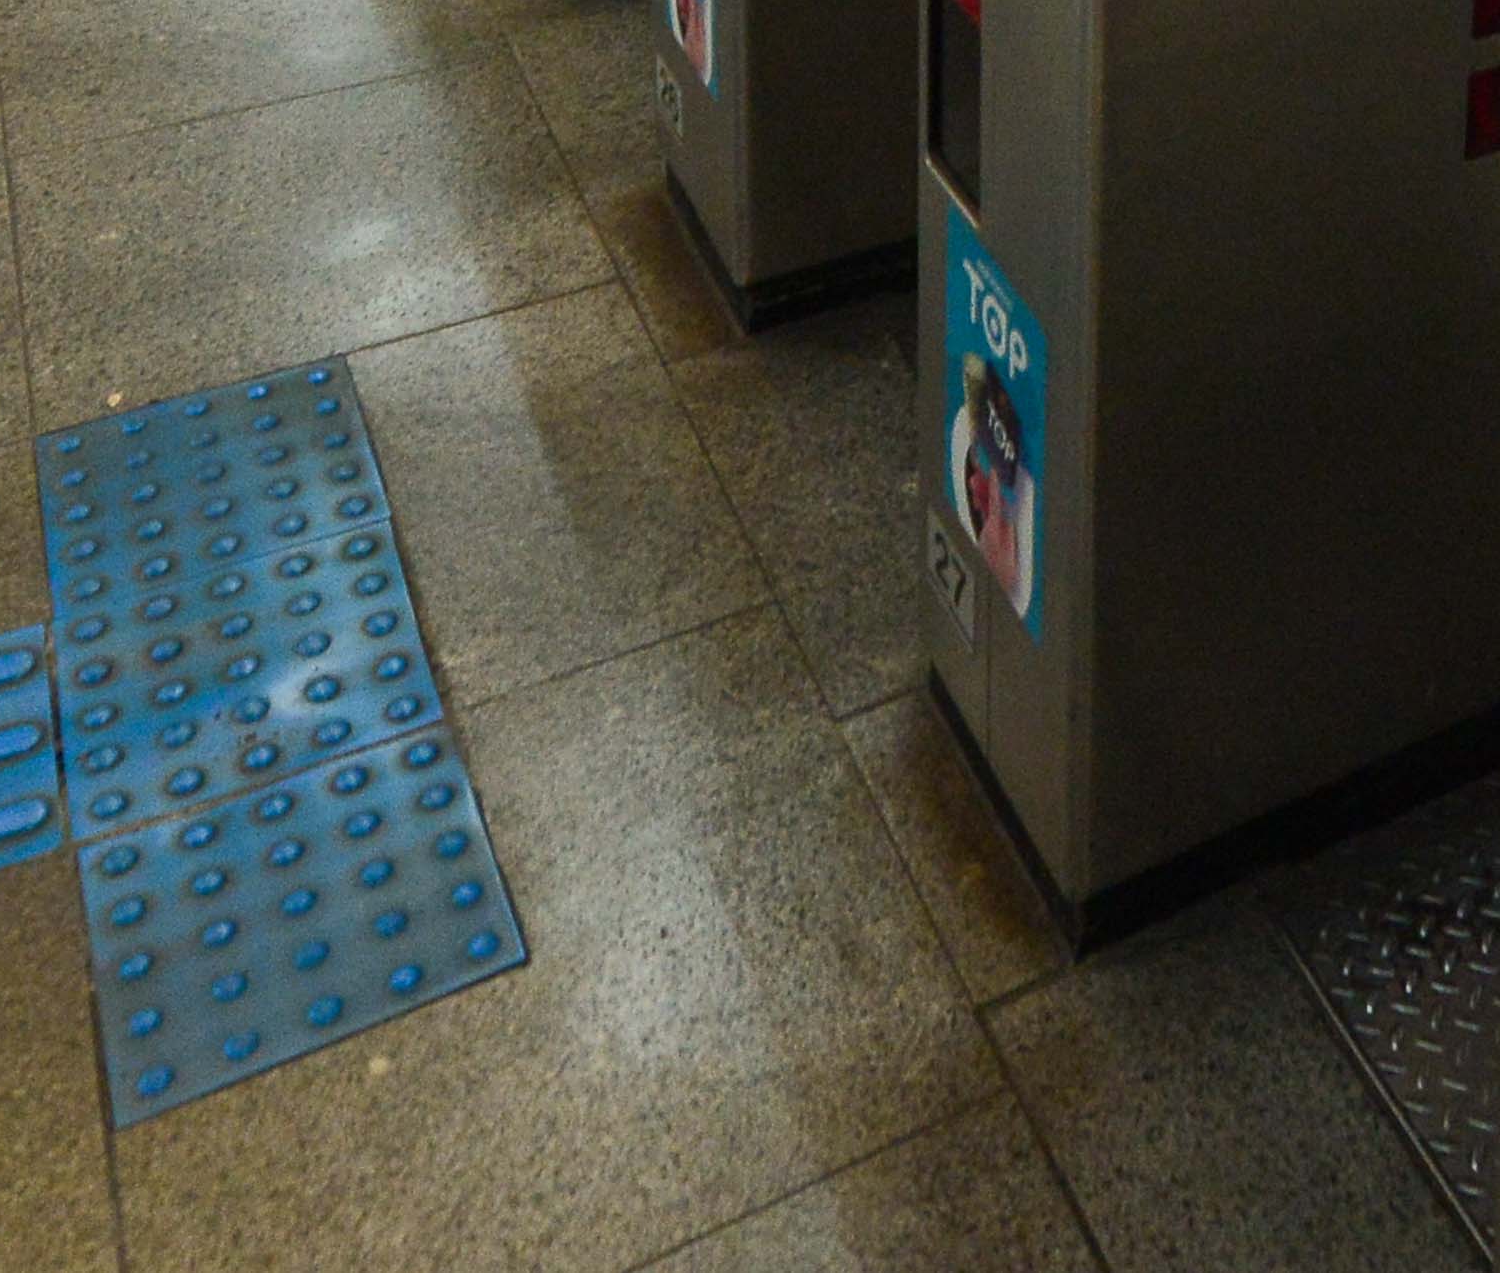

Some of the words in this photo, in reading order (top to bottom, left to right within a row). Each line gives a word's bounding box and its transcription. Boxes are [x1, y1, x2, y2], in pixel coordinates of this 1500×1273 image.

[962, 257, 1027, 379] TOP
[988, 400, 1015, 461] TOP
[935, 532, 966, 605] 27
